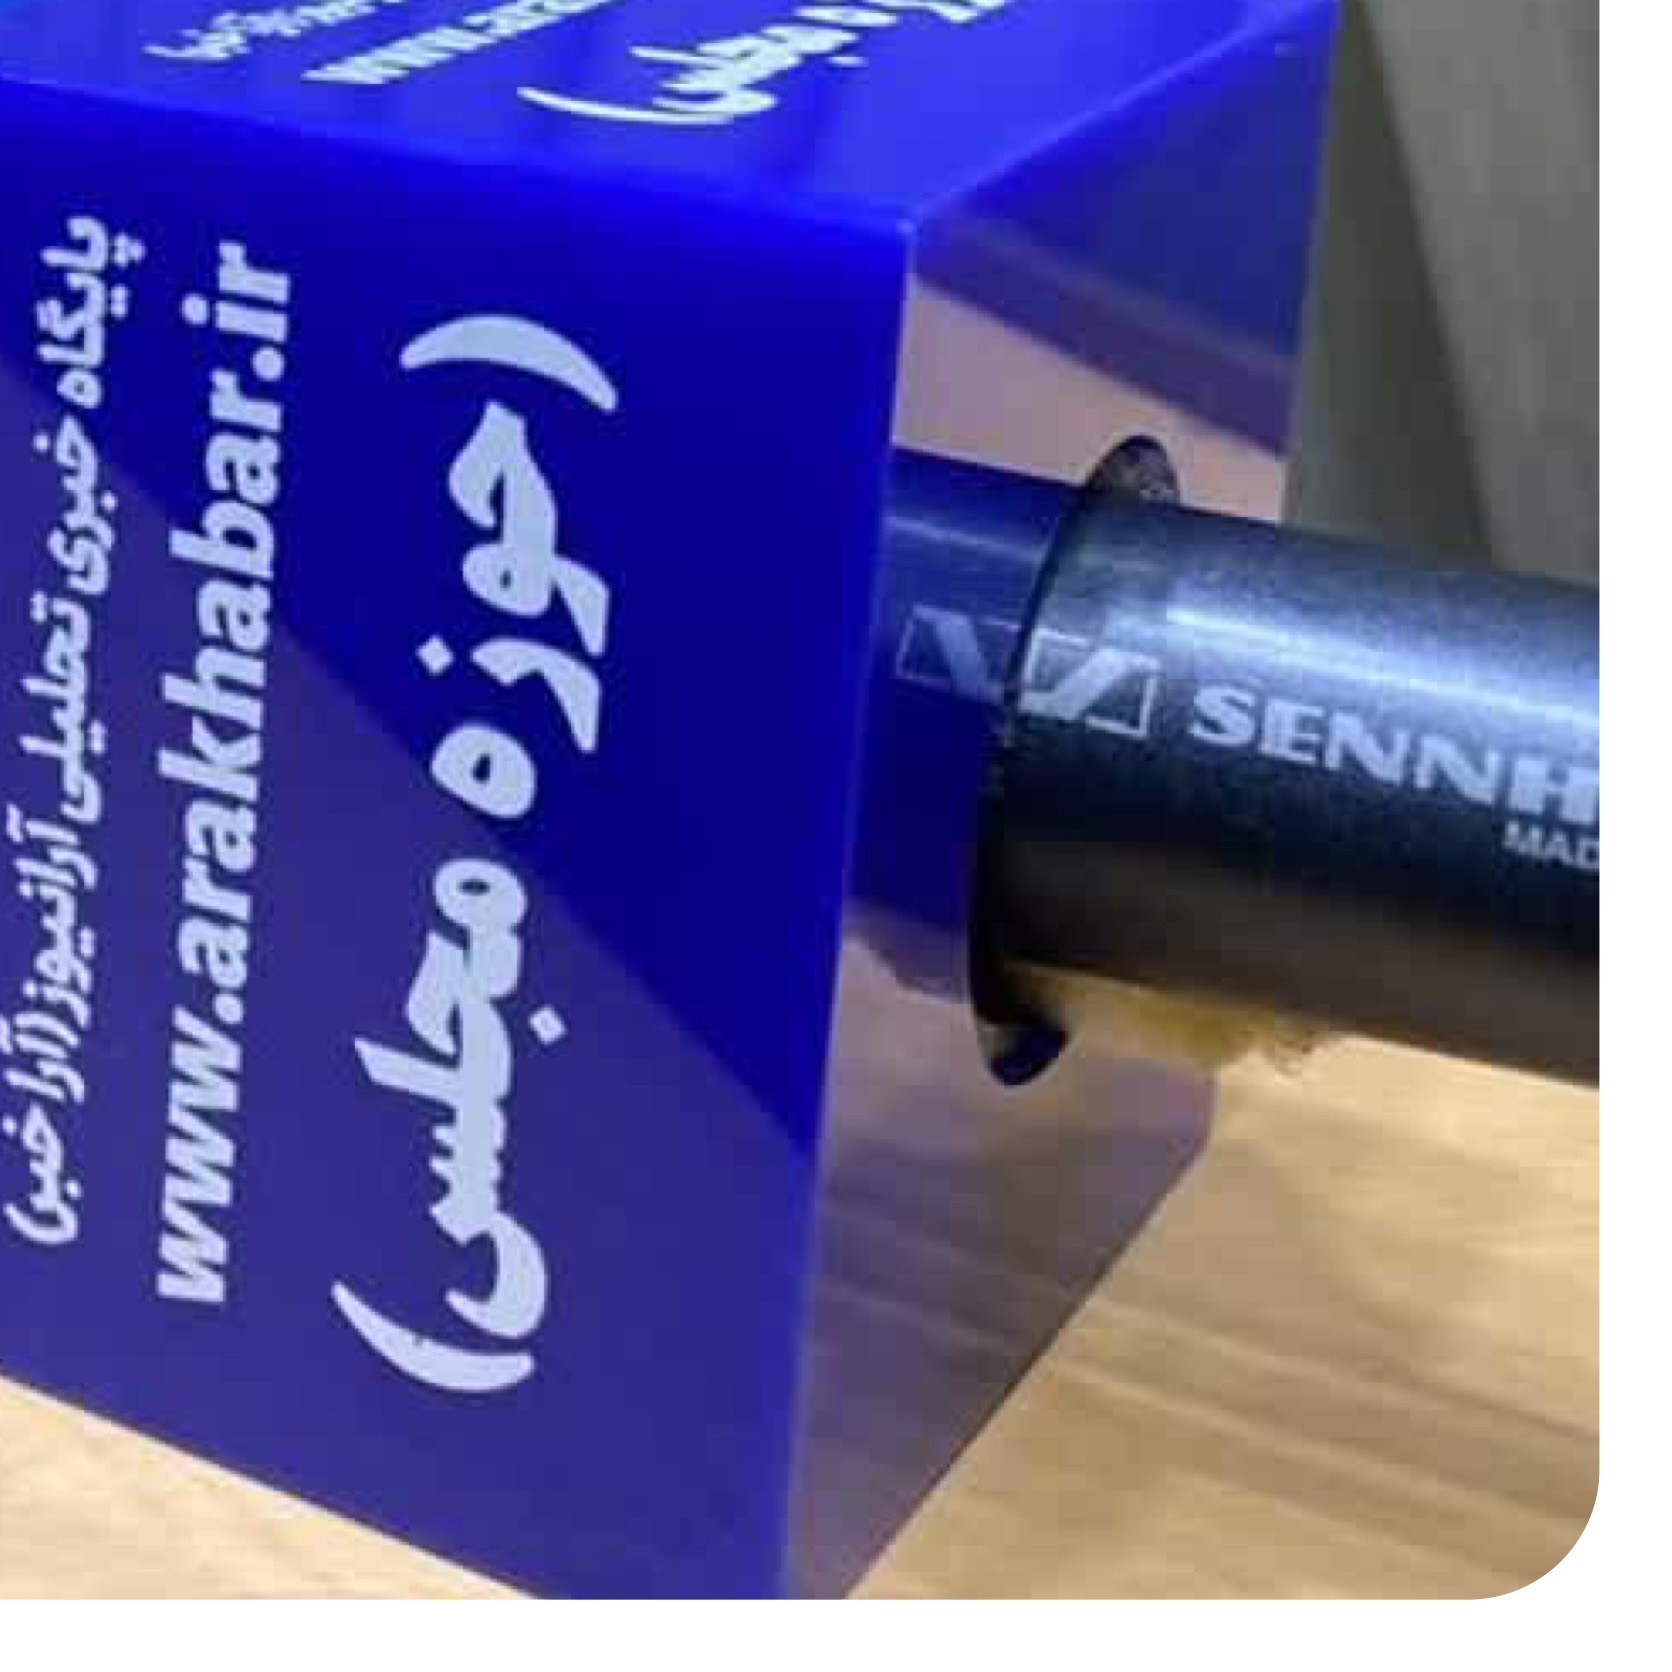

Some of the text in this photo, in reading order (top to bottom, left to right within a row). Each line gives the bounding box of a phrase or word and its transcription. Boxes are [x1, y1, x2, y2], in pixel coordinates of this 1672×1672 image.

[37, 217, 144, 410] پایگاه
[33, 416, 118, 596] خبری
[400, 315, 617, 818] (حوزه
[18, 590, 107, 824] تحلیلی
[157, 242, 289, 1304] www.arakhabar.ir
[330, 857, 566, 1392] مجلس)
